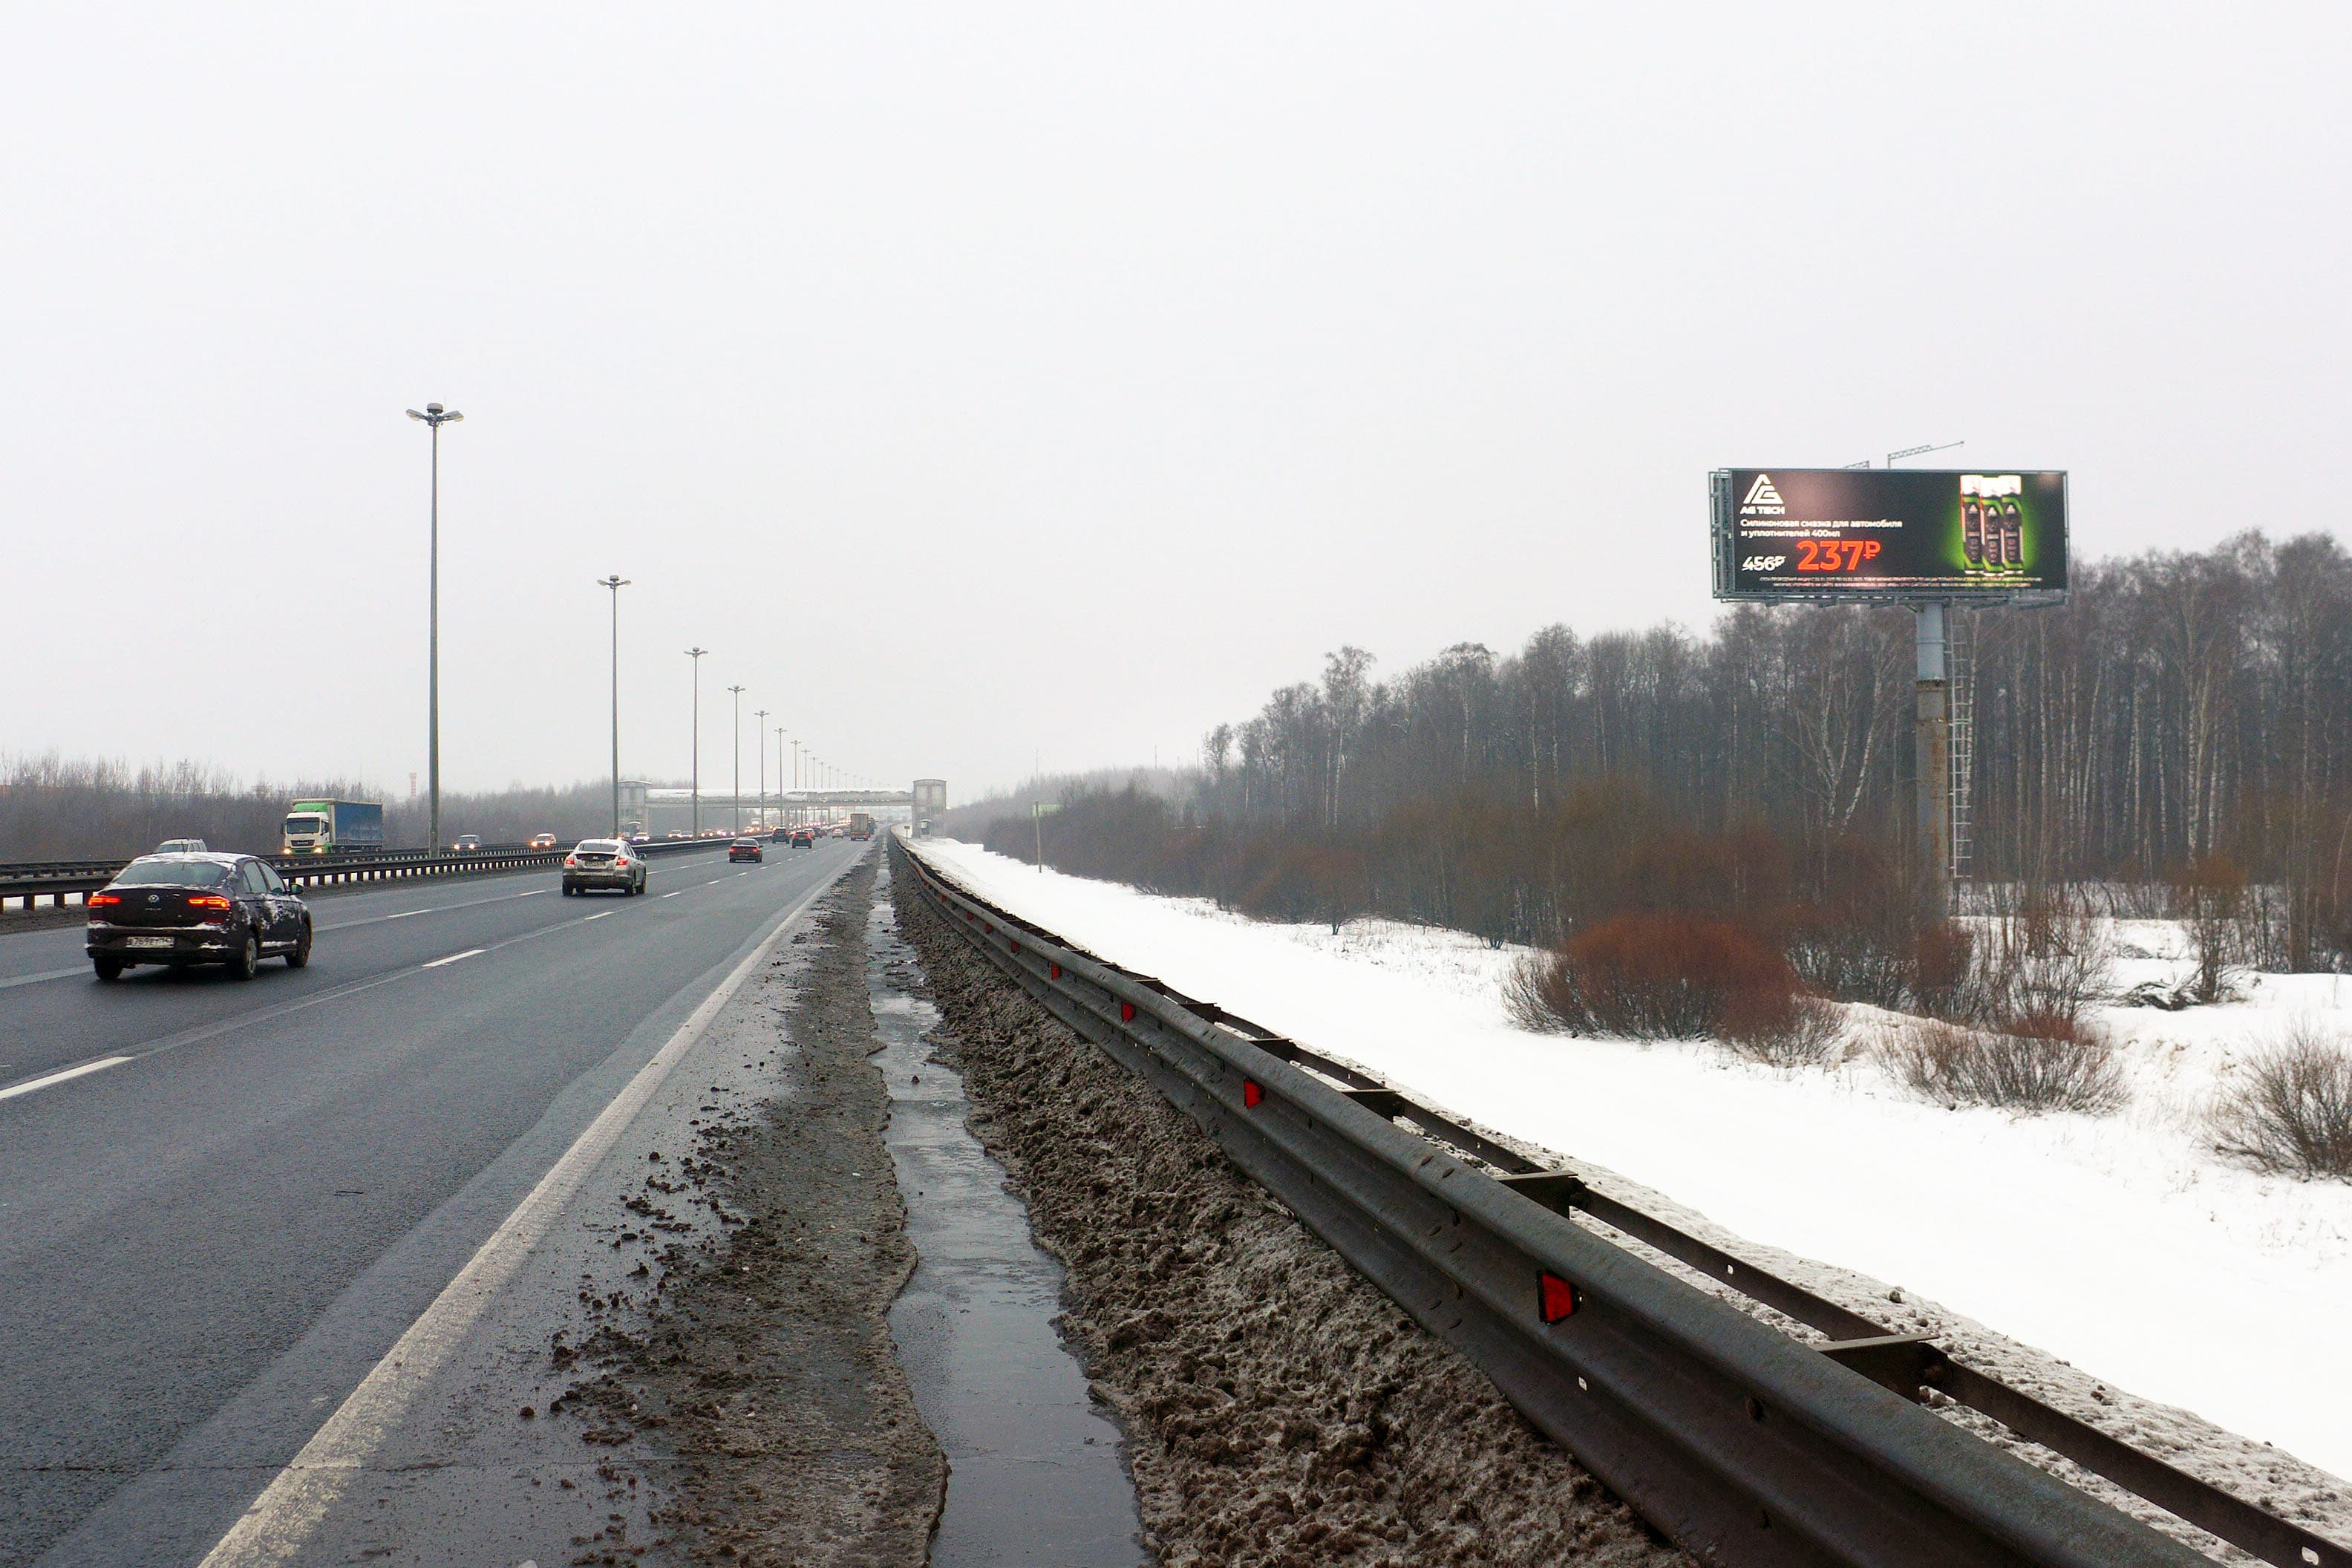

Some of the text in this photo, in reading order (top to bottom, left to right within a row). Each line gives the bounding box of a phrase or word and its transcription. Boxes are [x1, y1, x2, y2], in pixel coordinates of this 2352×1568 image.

[1757, 506, 1786, 514] TECH
[1740, 519, 1799, 528] Силиконовая
[1850, 519, 1903, 529] автомобиля
[1748, 529, 1810, 538] уплотнителей
